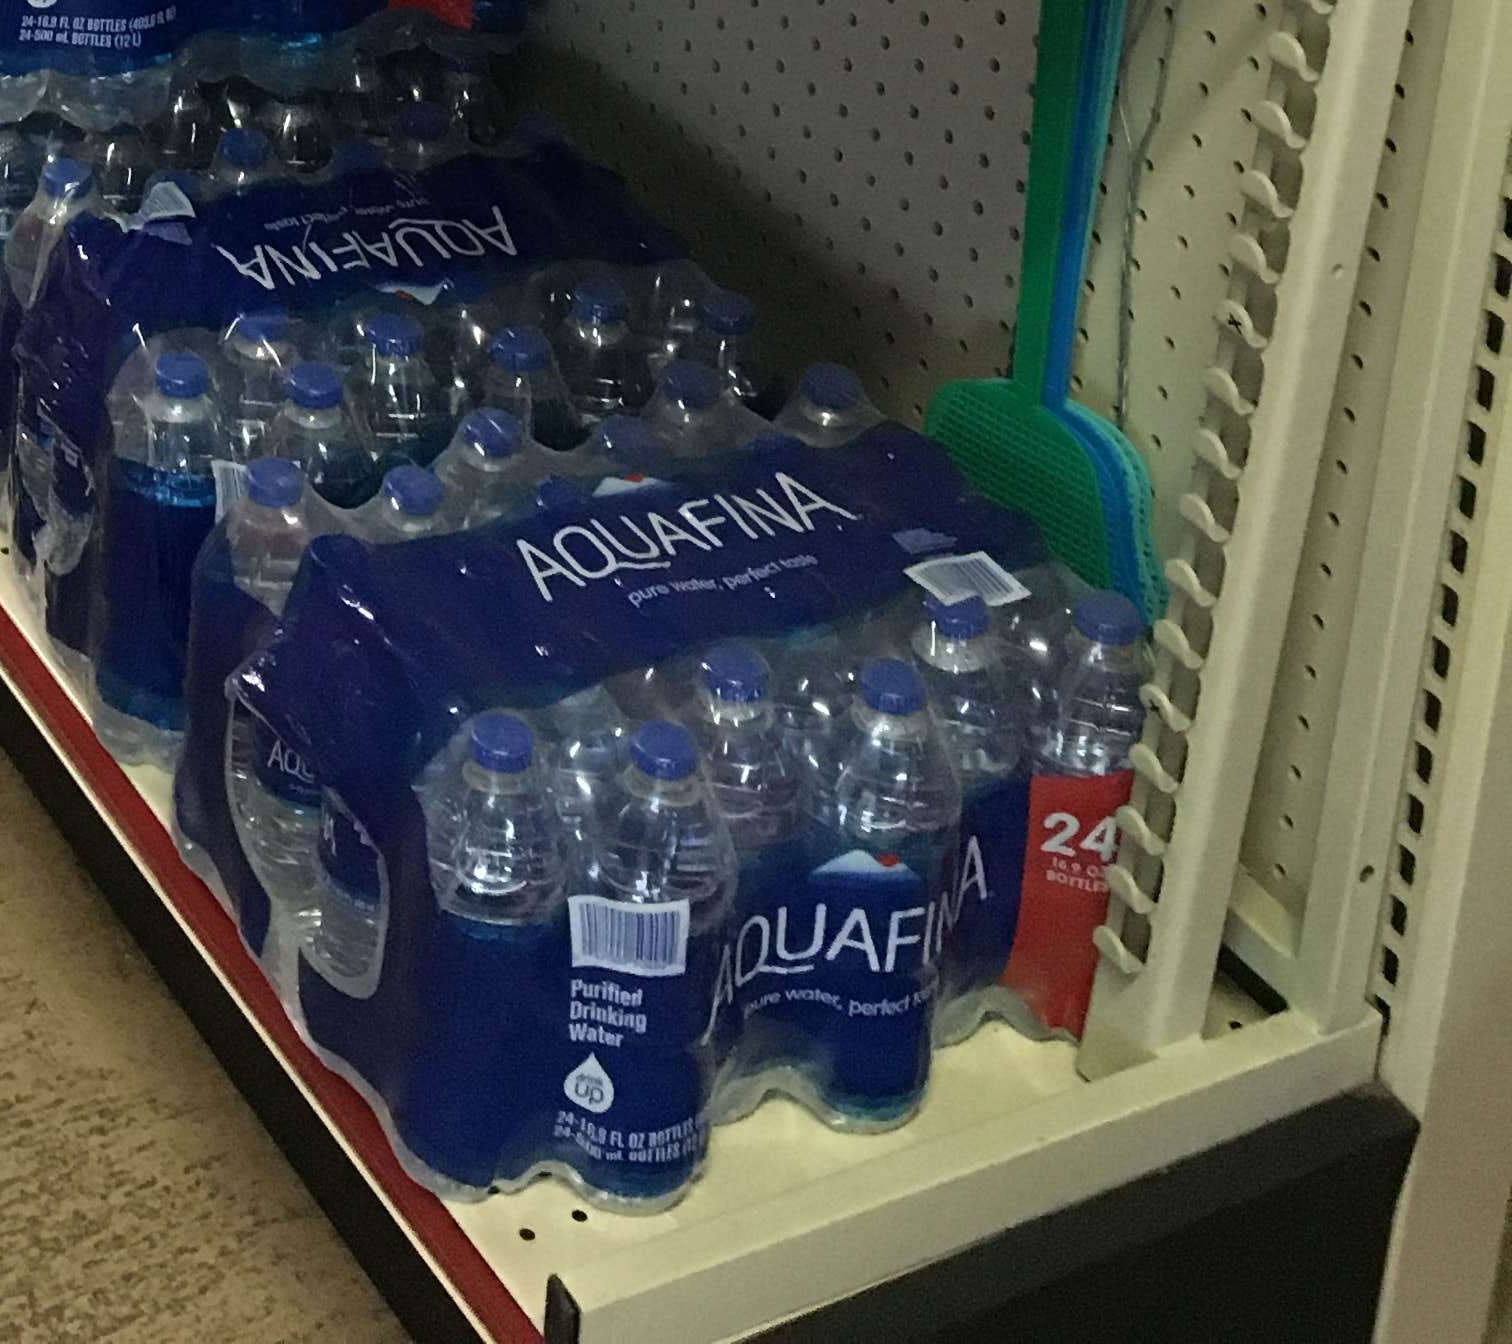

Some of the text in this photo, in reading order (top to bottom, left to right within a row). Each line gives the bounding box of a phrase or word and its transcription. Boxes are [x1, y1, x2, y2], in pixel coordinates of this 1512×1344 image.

[59, 16, 71, 28] FL
[72, 17, 85, 30] OZ
[88, 18, 127, 32] BOTTLES
[72, 32, 112, 48] BOTTLES
[211, 205, 518, 290] AQUAFINA
[516, 472, 859, 602] AQUAFINA
[628, 583, 669, 607] pure
[670, 578, 724, 593] water,
[726, 562, 781, 590] perfect
[1041, 813, 1118, 862] 24
[701, 835, 988, 1046] AQUAFINA
[571, 979, 643, 1007] Purified
[744, 990, 781, 1018] pure
[785, 986, 842, 1010] water,
[848, 995, 911, 1018] perfect
[570, 1000, 647, 1034] Drinking
[569, 1023, 624, 1047] Water
[574, 1083, 604, 1105] up
[610, 1132, 625, 1149] FL
[629, 1132, 645, 1149] OZ
